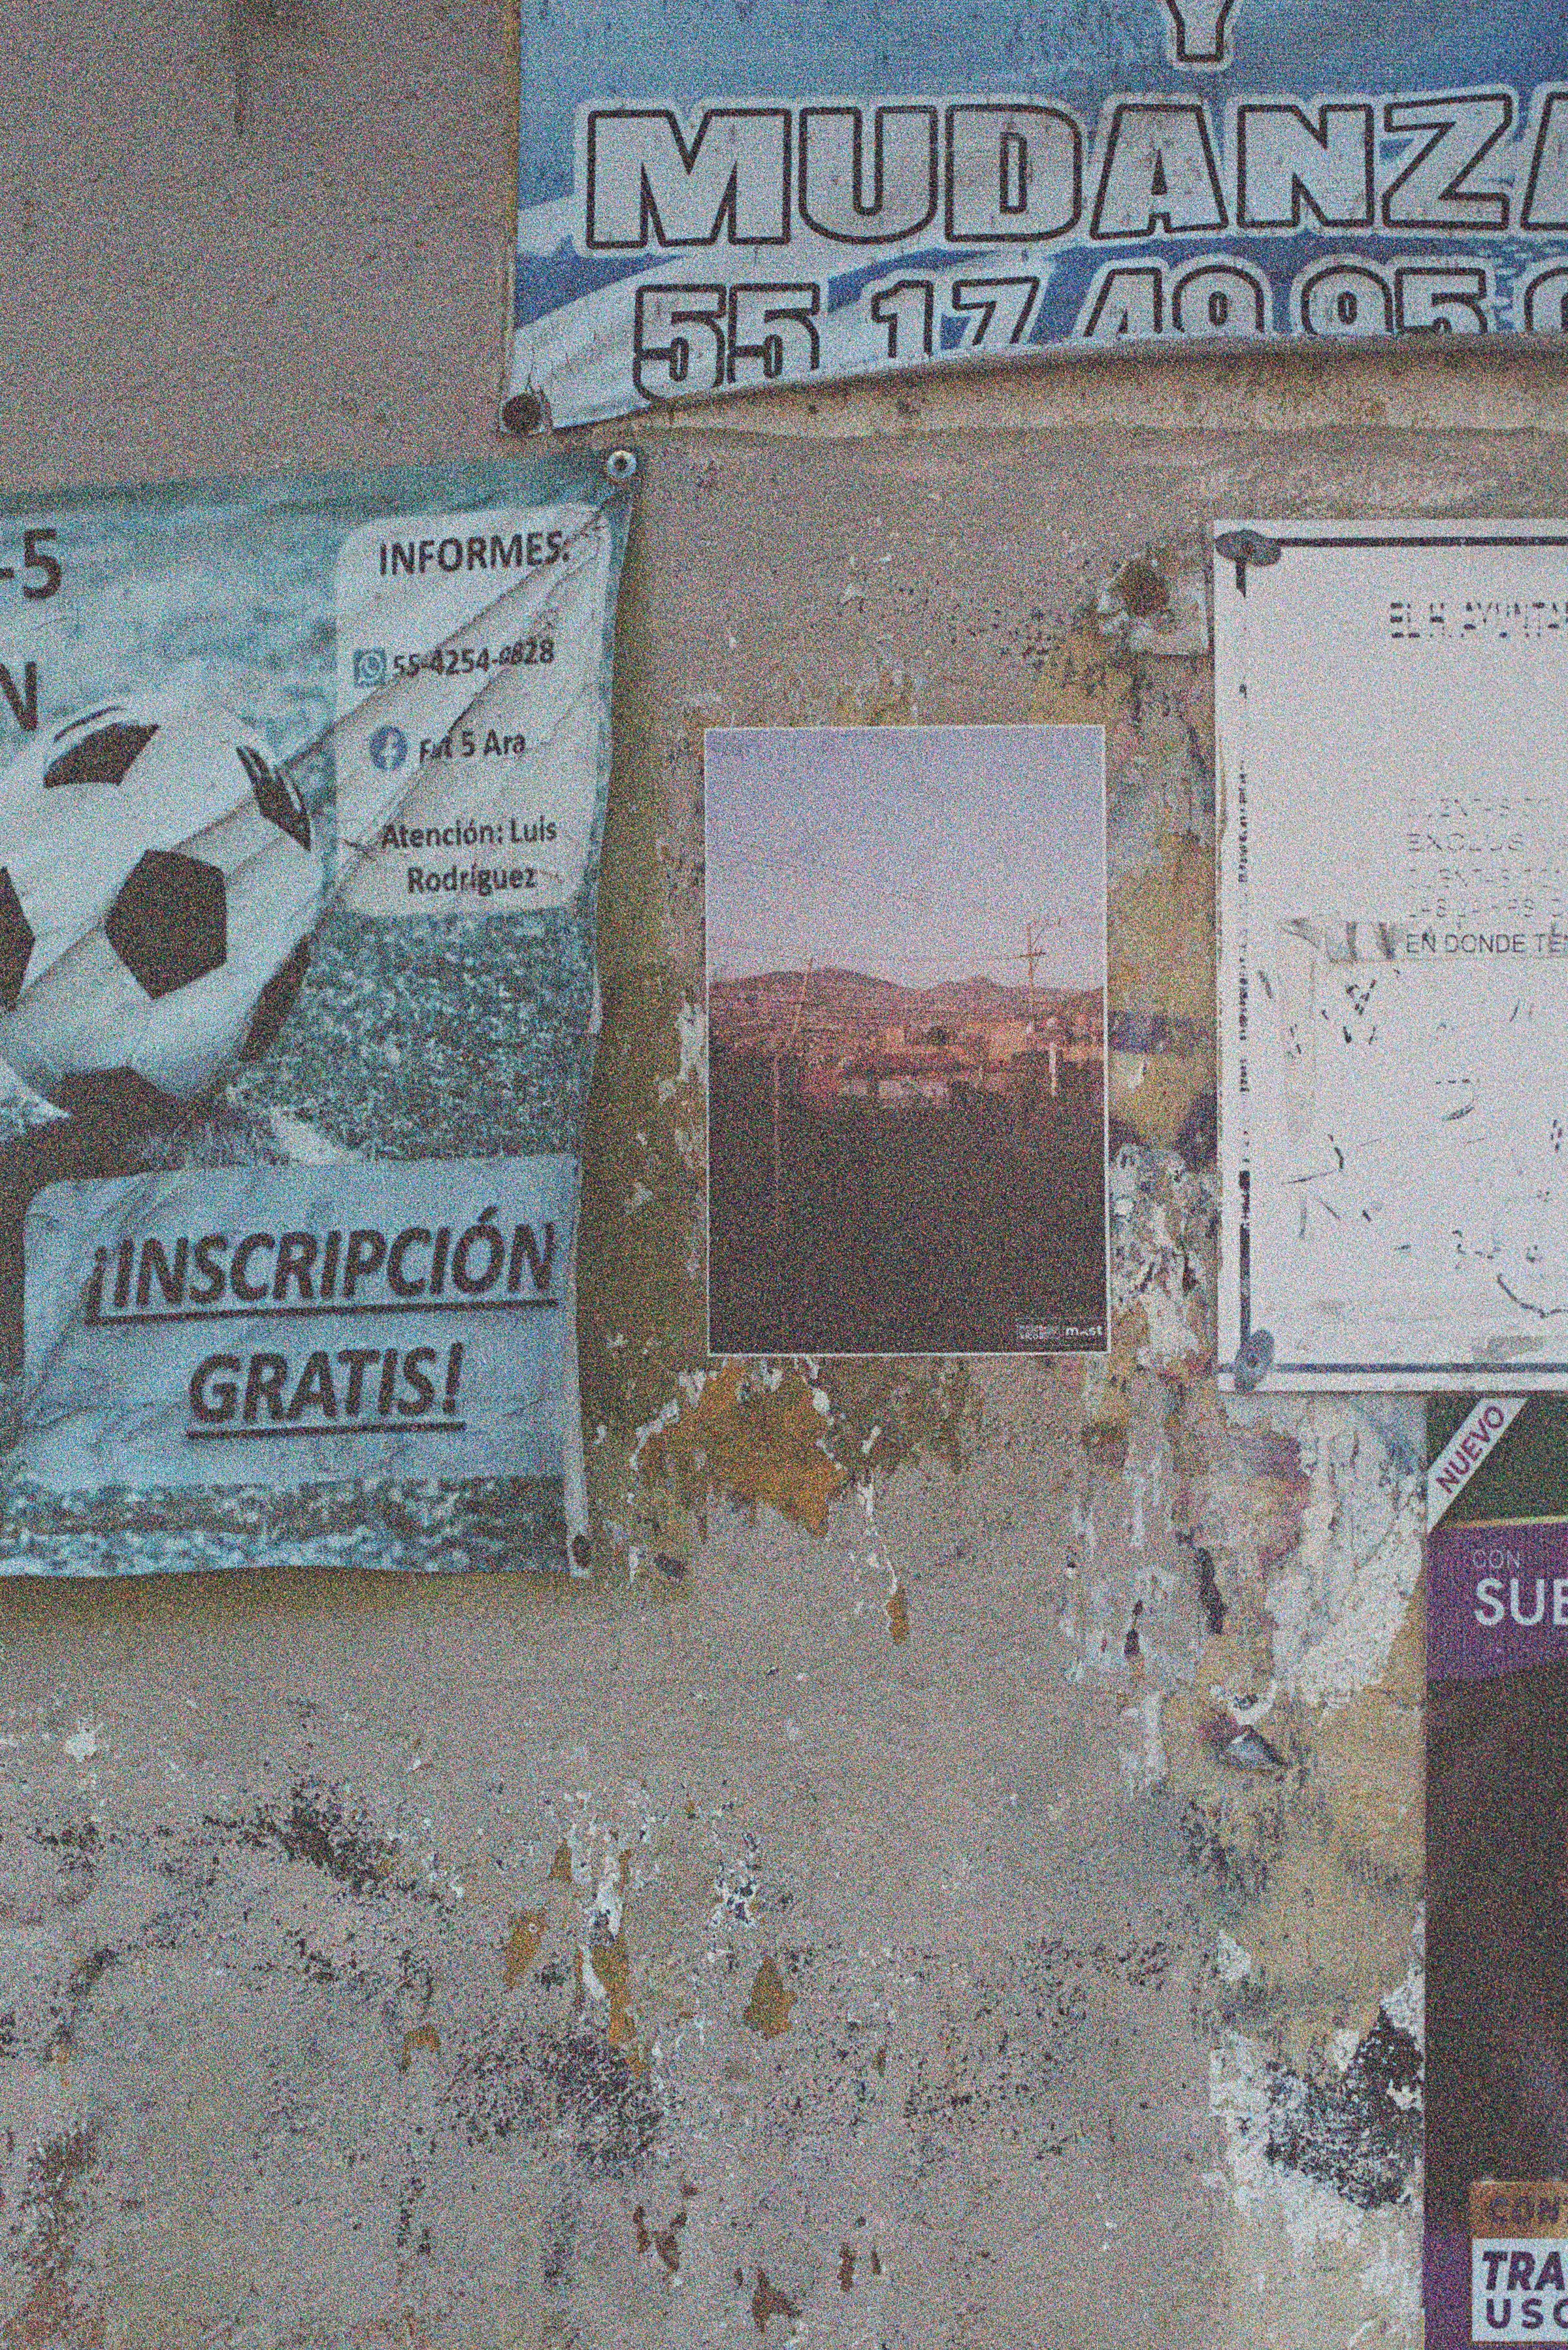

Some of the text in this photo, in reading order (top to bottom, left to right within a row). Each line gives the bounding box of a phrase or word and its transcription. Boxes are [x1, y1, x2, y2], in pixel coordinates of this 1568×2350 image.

[461, 730, 476, 757] 5
[483, 728, 526, 756] Ara
[382, 815, 557, 849] Atención: Luis
[1406, 933, 1568, 954] EN DONDE TE
[188, 1342, 465, 1423] GRATIS!
[1435, 1405, 1505, 1494] NUEVO
[1473, 1549, 1521, 1569] CON
[1490, 2196, 1568, 2224] CON
[1482, 2251, 1565, 2291] TRA
